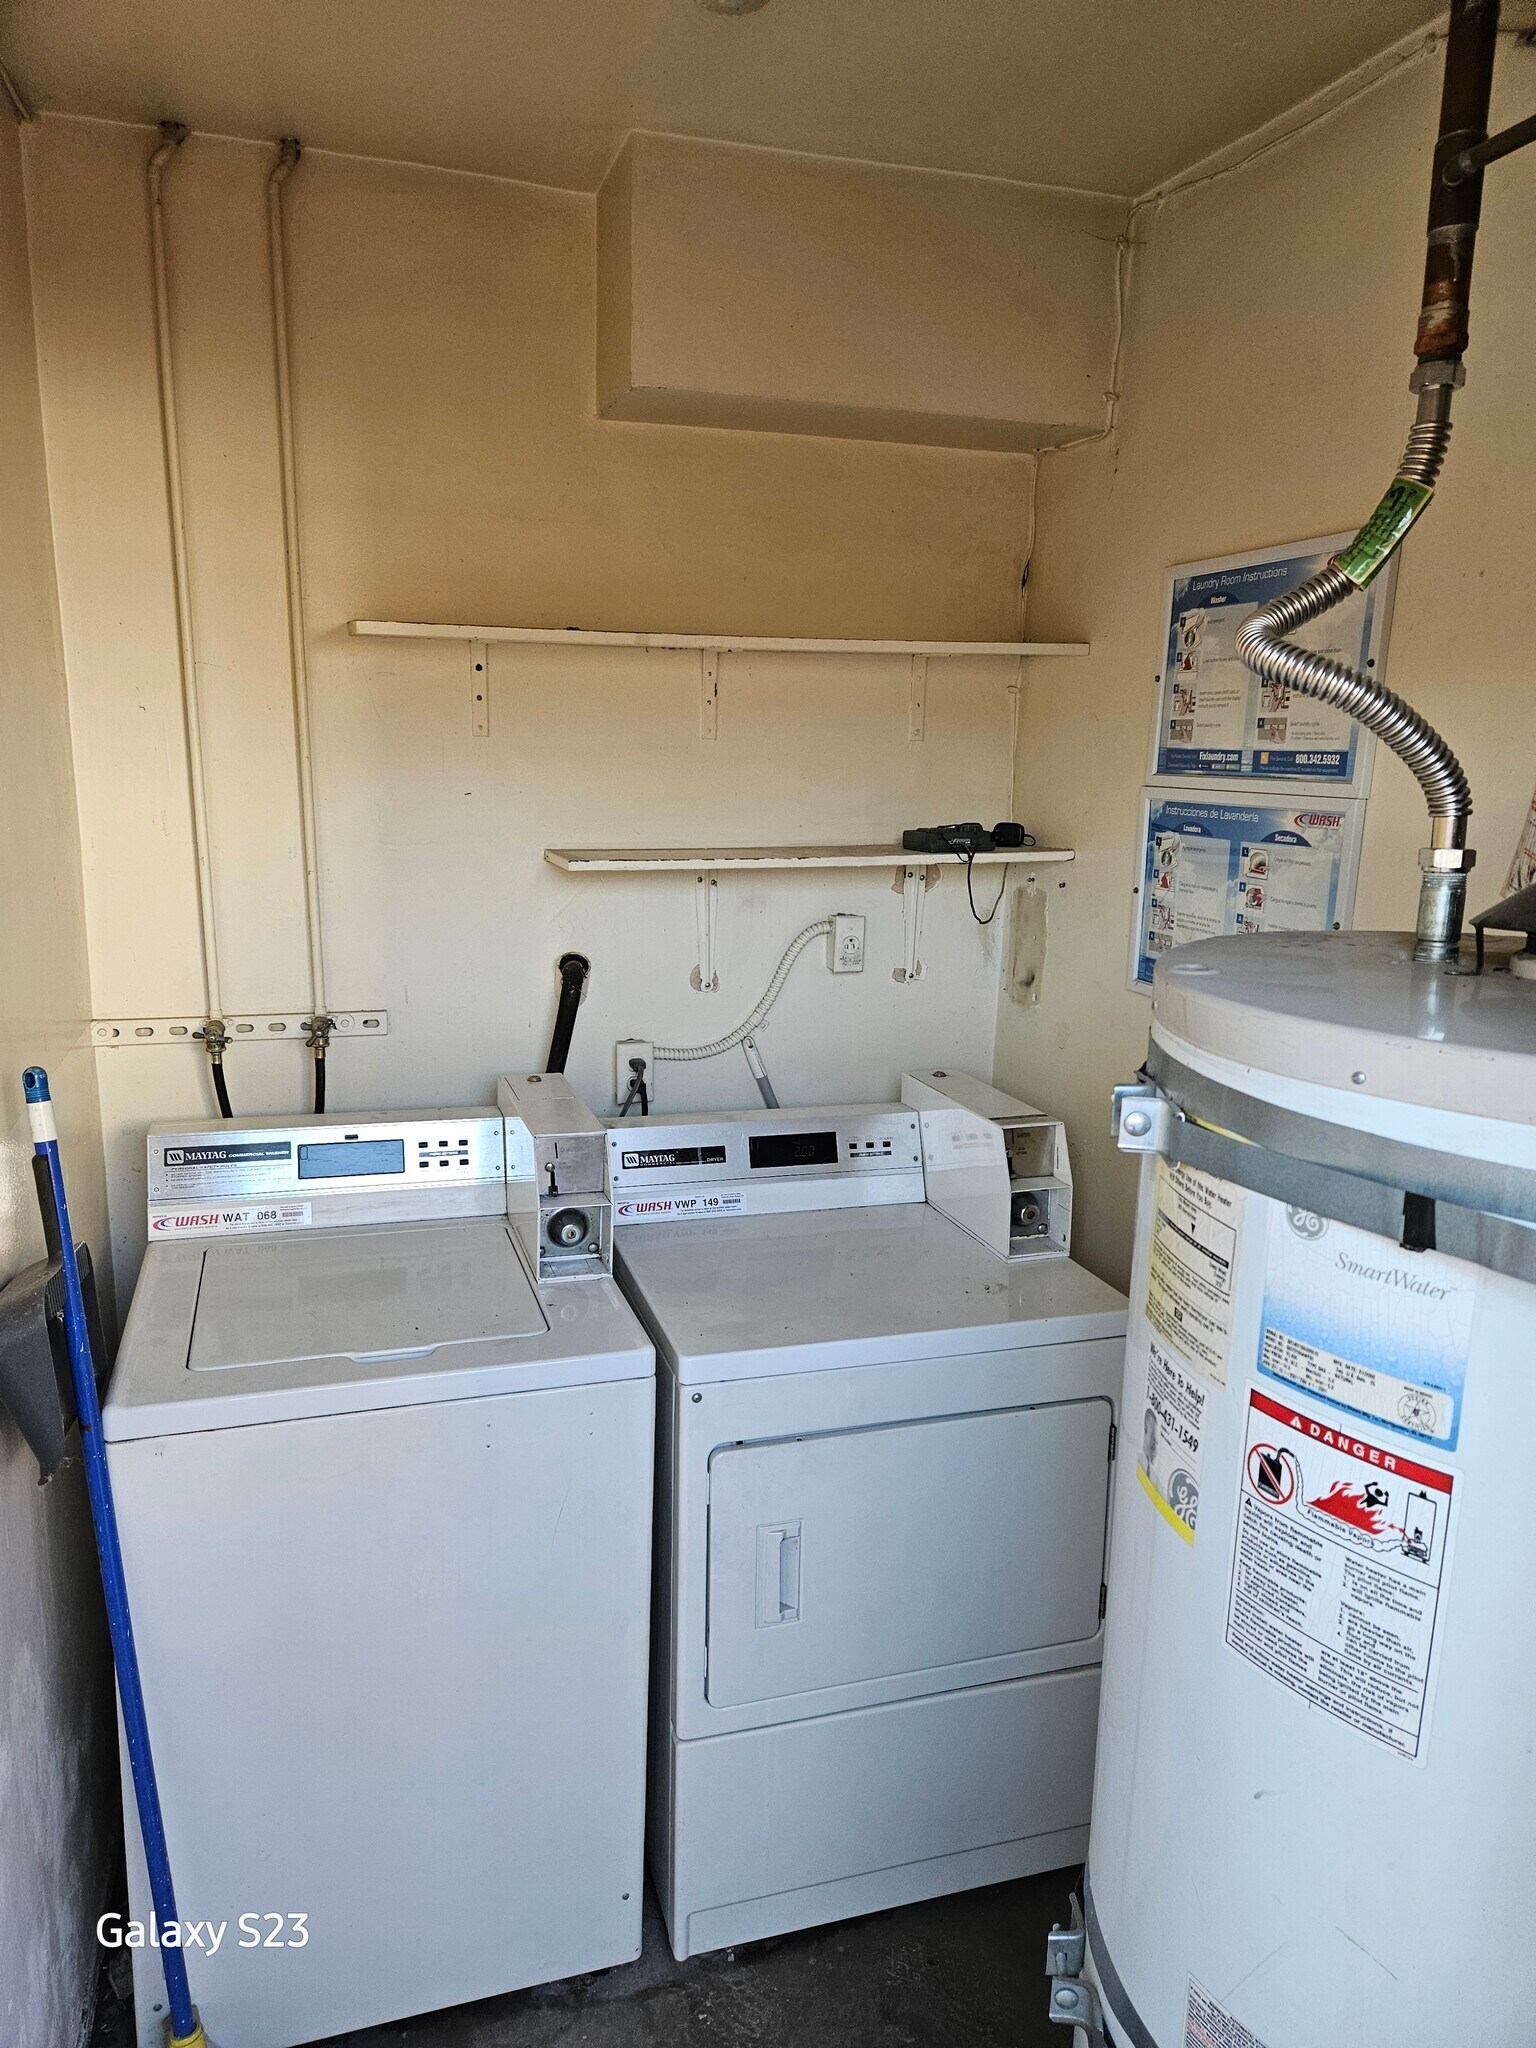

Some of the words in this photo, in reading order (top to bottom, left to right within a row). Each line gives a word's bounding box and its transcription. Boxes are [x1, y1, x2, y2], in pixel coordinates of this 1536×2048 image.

[1192, 578, 1220, 591] Laundry
[1221, 574, 1241, 585] Room
[1243, 566, 1288, 582] Instructions
[1210, 595, 1227, 604] Washer
[1199, 751, 1238, 763] Fixlaundry.com
[1295, 754, 1340, 765] 800.342.5932
[1165, 805, 1208, 818] Instrucciones
[1209, 809, 1218, 819] de
[1220, 810, 1259, 822] Lavandería
[1309, 814, 1341, 827] WASH
[1183, 824, 1202, 833] Lavadora
[1274, 833, 1297, 843] Secadora
[185, 1151, 227, 1160] MAYTAG
[640, 1154, 675, 1163] MAYTAG
[175, 1214, 219, 1227] WASH
[222, 1212, 250, 1223] WAT
[257, 1210, 277, 1220] 068
[636, 1201, 672, 1213] WASH
[674, 1199, 697, 1209] VWP
[702, 1197, 719, 1207] 149
[1335, 1252, 1450, 1301] SmartWater
[1163, 1359, 1176, 1381] Here
[1177, 1373, 1184, 1388] To
[1185, 1382, 1205, 1406] Help!
[1146, 1385, 1199, 1453] 1-800-431-1549
[1309, 1423, 1397, 1471] DANGER
[1307, 1509, 1347, 1533] Flammable
[1348, 1529, 1375, 1547] Vapors
[1343, 1568, 1355, 1578] The
[1357, 1575, 1371, 1587] pilot
[1344, 1562, 1365, 1576] burner
[1368, 1573, 1380, 1583] and
[1381, 1580, 1397, 1592] pilot
[1345, 1556, 1363, 1568] Water
[1365, 1565, 1386, 1579] heater
[1388, 1576, 1400, 1585] has
[1408, 1584, 1426, 1597] main
[1351, 1586, 1362, 1595] will
[1364, 1592, 1382, 1606] ignite
[1384, 1601, 1420, 1622] flammable
[1379, 1592, 1390, 1601] the
[1392, 1598, 1407, 1609] time
[1409, 1605, 1422, 1615] and
[1348, 1611, 1370, 1626] cannot
[1346, 1630, 1360, 1641] floor
[1363, 1638, 1375, 1648] and
[1347, 1618, 1357, 1626] are
[1359, 1623, 1384, 1639] heavier
[1386, 1636, 1401, 1647] than
[1343, 1647, 1361, 1660] flame
[1373, 1662, 1381, 1671] air
[1345, 1636, 1356, 1645] can
[1368, 1647, 1392, 1662] carried
[1393, 1659, 1410, 1671] from
[1362, 1632, 1377, 1643] long
[1379, 1640, 1391, 1651] way
[1404, 1652, 1415, 1661] the
[1339, 1659, 1355, 1671] least
[1356, 1668, 1367, 1677] 18"
[1369, 1674, 1389, 1689] above
[1391, 1685, 1402, 1695] the
[1344, 1642, 1361, 1654] other
[1363, 1651, 1384, 1665] rooms
[1394, 1666, 1405, 1675] the
[1407, 1671, 1423, 1685] pilot
[1317, 1676, 1338, 1690] burner
[1347, 1692, 1362, 1705] pilot
[1318, 1669, 1335, 1683] being
[1336, 1679, 1359, 1695] ignited
[1370, 1697, 1381, 1706] the
[1382, 1703, 1399, 1715] main
[1339, 1666, 1353, 1677] This
[1354, 1674, 1366, 1684] will
[1394, 1694, 1405, 1704] but
[1407, 1700, 1420, 1711] not
[1350, 1680, 1361, 1689] the
[1362, 1686, 1375, 1696] risk
[1385, 1697, 1409, 1714] vapors
